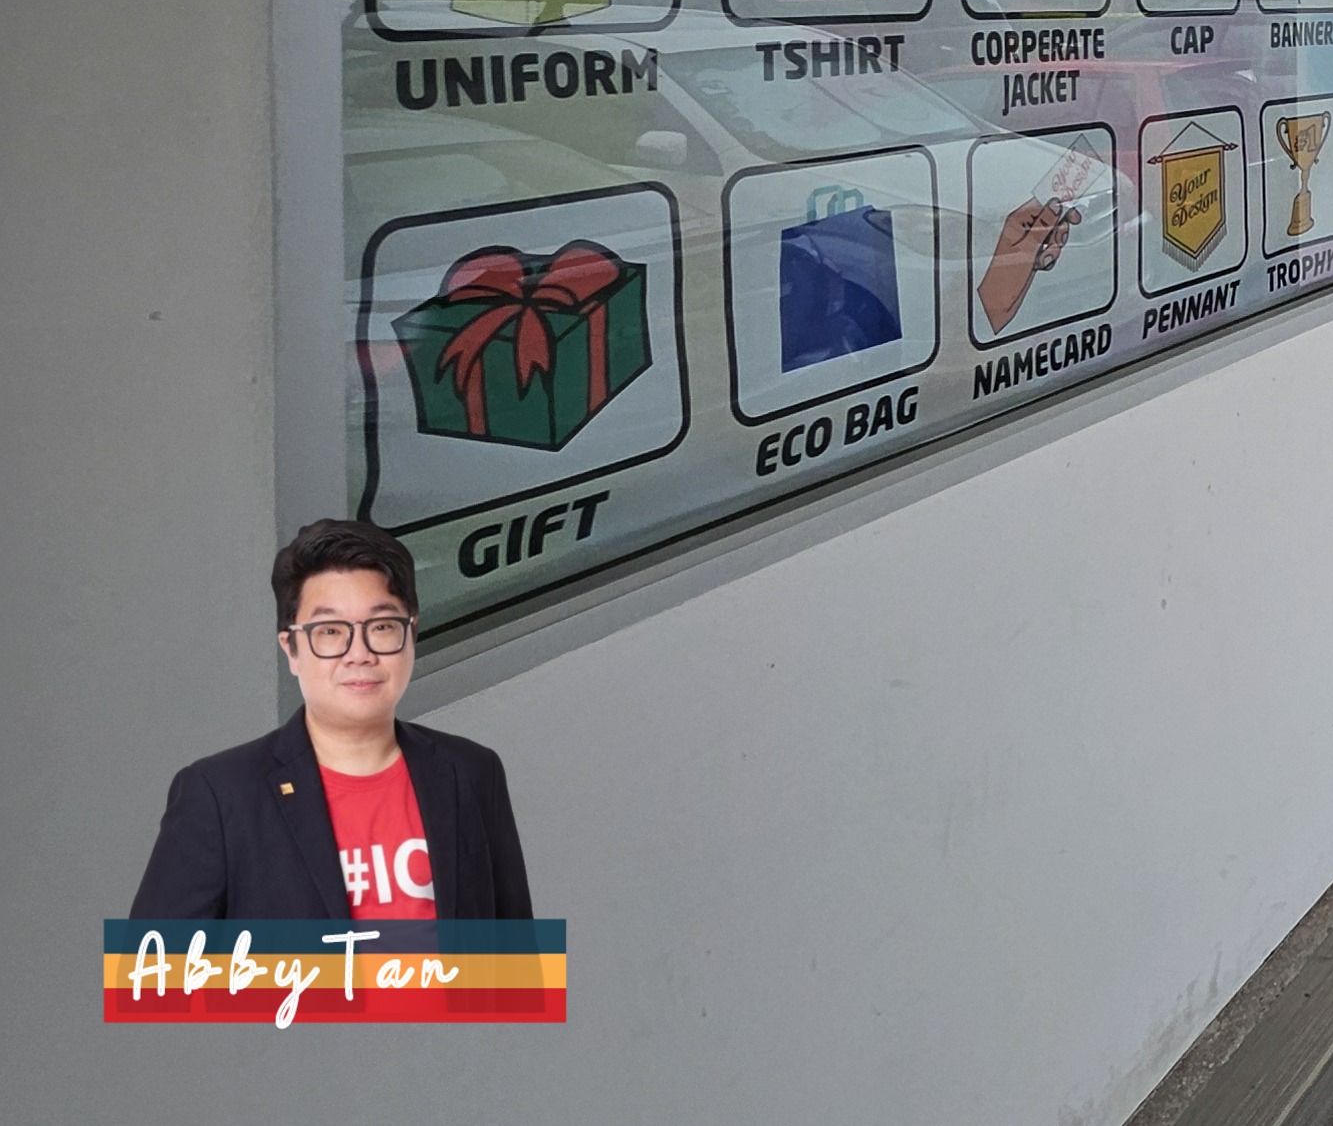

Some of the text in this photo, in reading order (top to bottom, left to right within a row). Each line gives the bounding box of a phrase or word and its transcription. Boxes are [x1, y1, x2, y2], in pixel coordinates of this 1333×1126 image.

[971, 27, 1104, 65] CORPERATE
[1170, 25, 1214, 55] CAP
[1270, 20, 1333, 48] BANNER
[396, 48, 658, 110] UNIFORM
[755, 35, 904, 81] TSHIRT
[1002, 70, 1080, 115] JACKET
[1169, 168, 1211, 207] Your
[1171, 188, 1218, 228] Design
[1142, 280, 1240, 340] PENNANT
[972, 323, 1112, 399] NAMECARD
[756, 386, 919, 476] ECO BAG
[458, 490, 609, 577] GIFT
